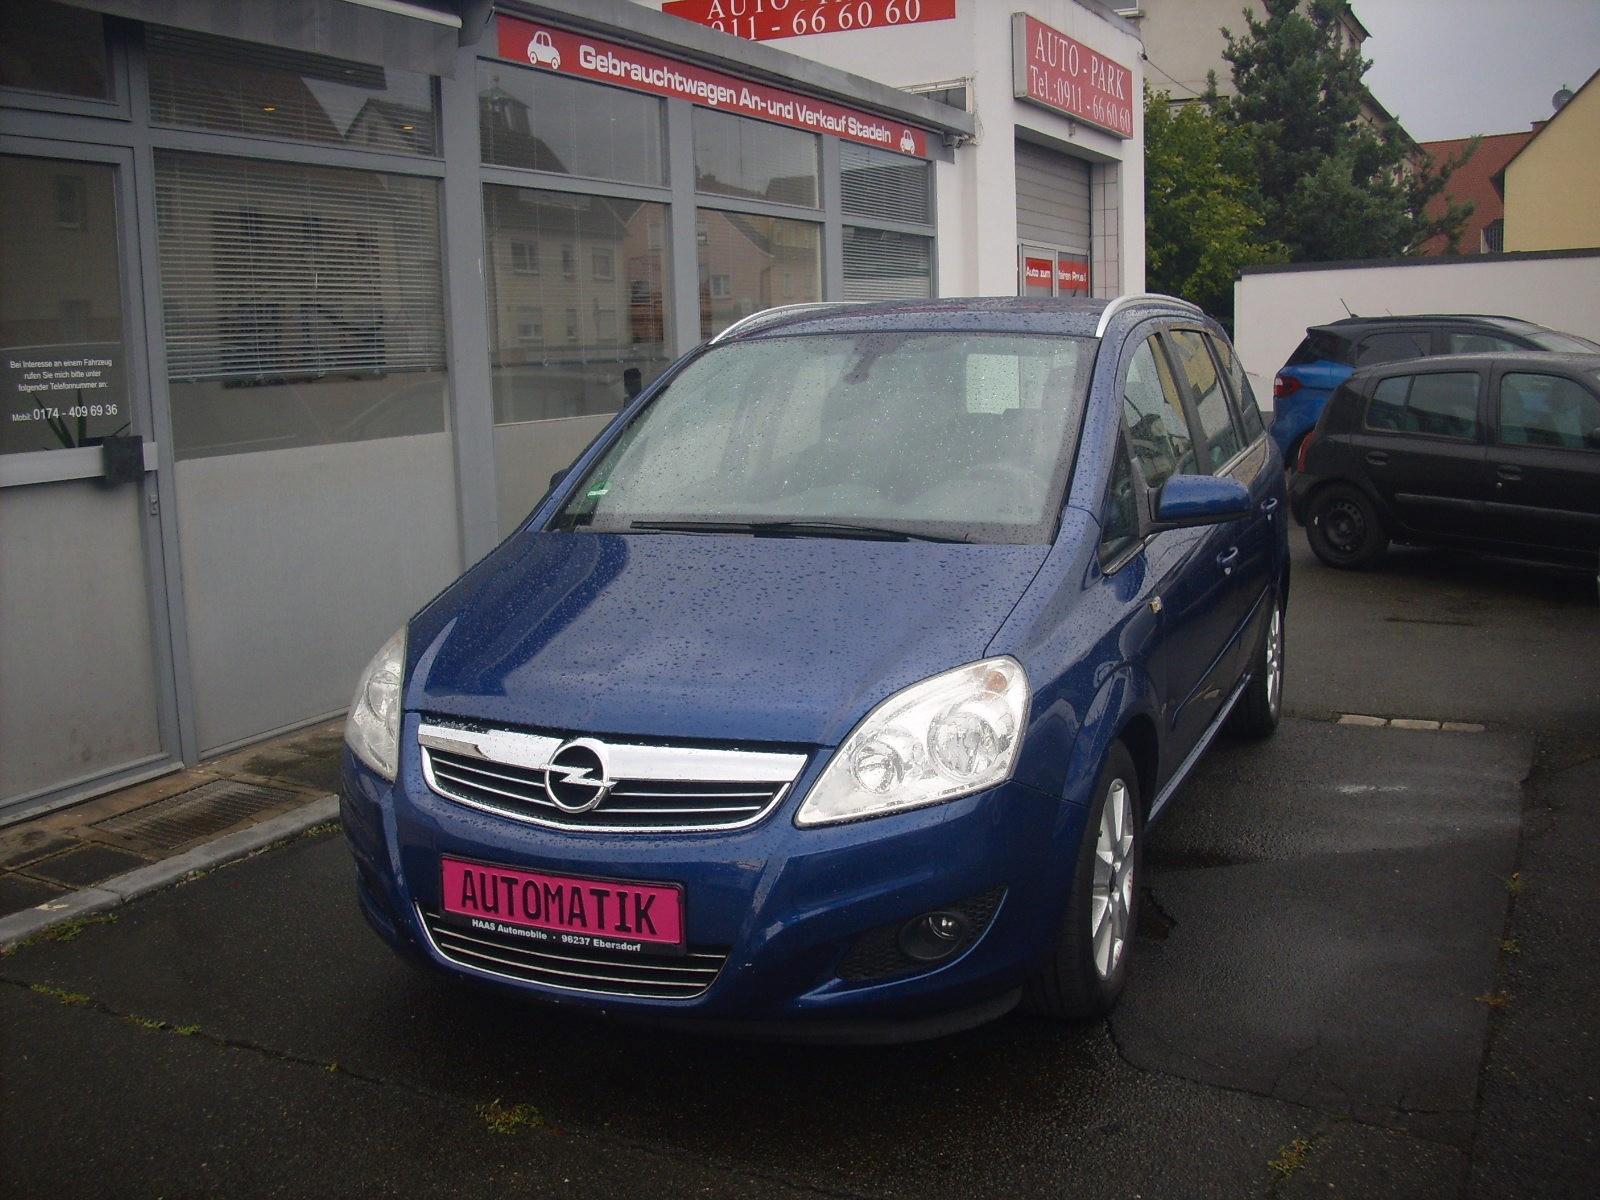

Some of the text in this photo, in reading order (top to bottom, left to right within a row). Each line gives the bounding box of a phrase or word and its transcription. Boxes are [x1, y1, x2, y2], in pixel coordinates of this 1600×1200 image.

[792, 9, 826, 34] 66
[838, 2, 873, 29] 60
[885, 0, 921, 24] 60
[1035, 27, 1080, 77] AUTO
[1091, 55, 1125, 101] PARK
[579, 44, 737, 105] Gebrauchtwagen
[795, 103, 847, 132] Verkauf
[847, 116, 892, 143] Stadeln
[1092, 94, 1105, 122] 66
[1106, 101, 1118, 128] 60
[1120, 107, 1131, 133] 60
[1026, 266, 1039, 278] Auto
[10, 361, 21, 369] Bei
[22, 360, 53, 368] Interesse
[83, 358, 113, 367] Fahrzeug
[42, 371, 53, 379] Sie
[54, 371, 70, 379] mich
[70, 370, 84, 378] bitte
[18, 383, 49, 393] folgender
[50, 382, 97, 390] Telefonnummer
[33, 408, 60, 420] 0174
[69, 406, 88, 418] 409
[90, 405, 103, 417] 69
[105, 403, 118, 416] 36
[461, 869, 658, 935] AUTOMATIK
[472, 919, 496, 931] HAAS
[497, 924, 547, 940] Automobile
[593, 938, 641, 952] Ebersdorf
